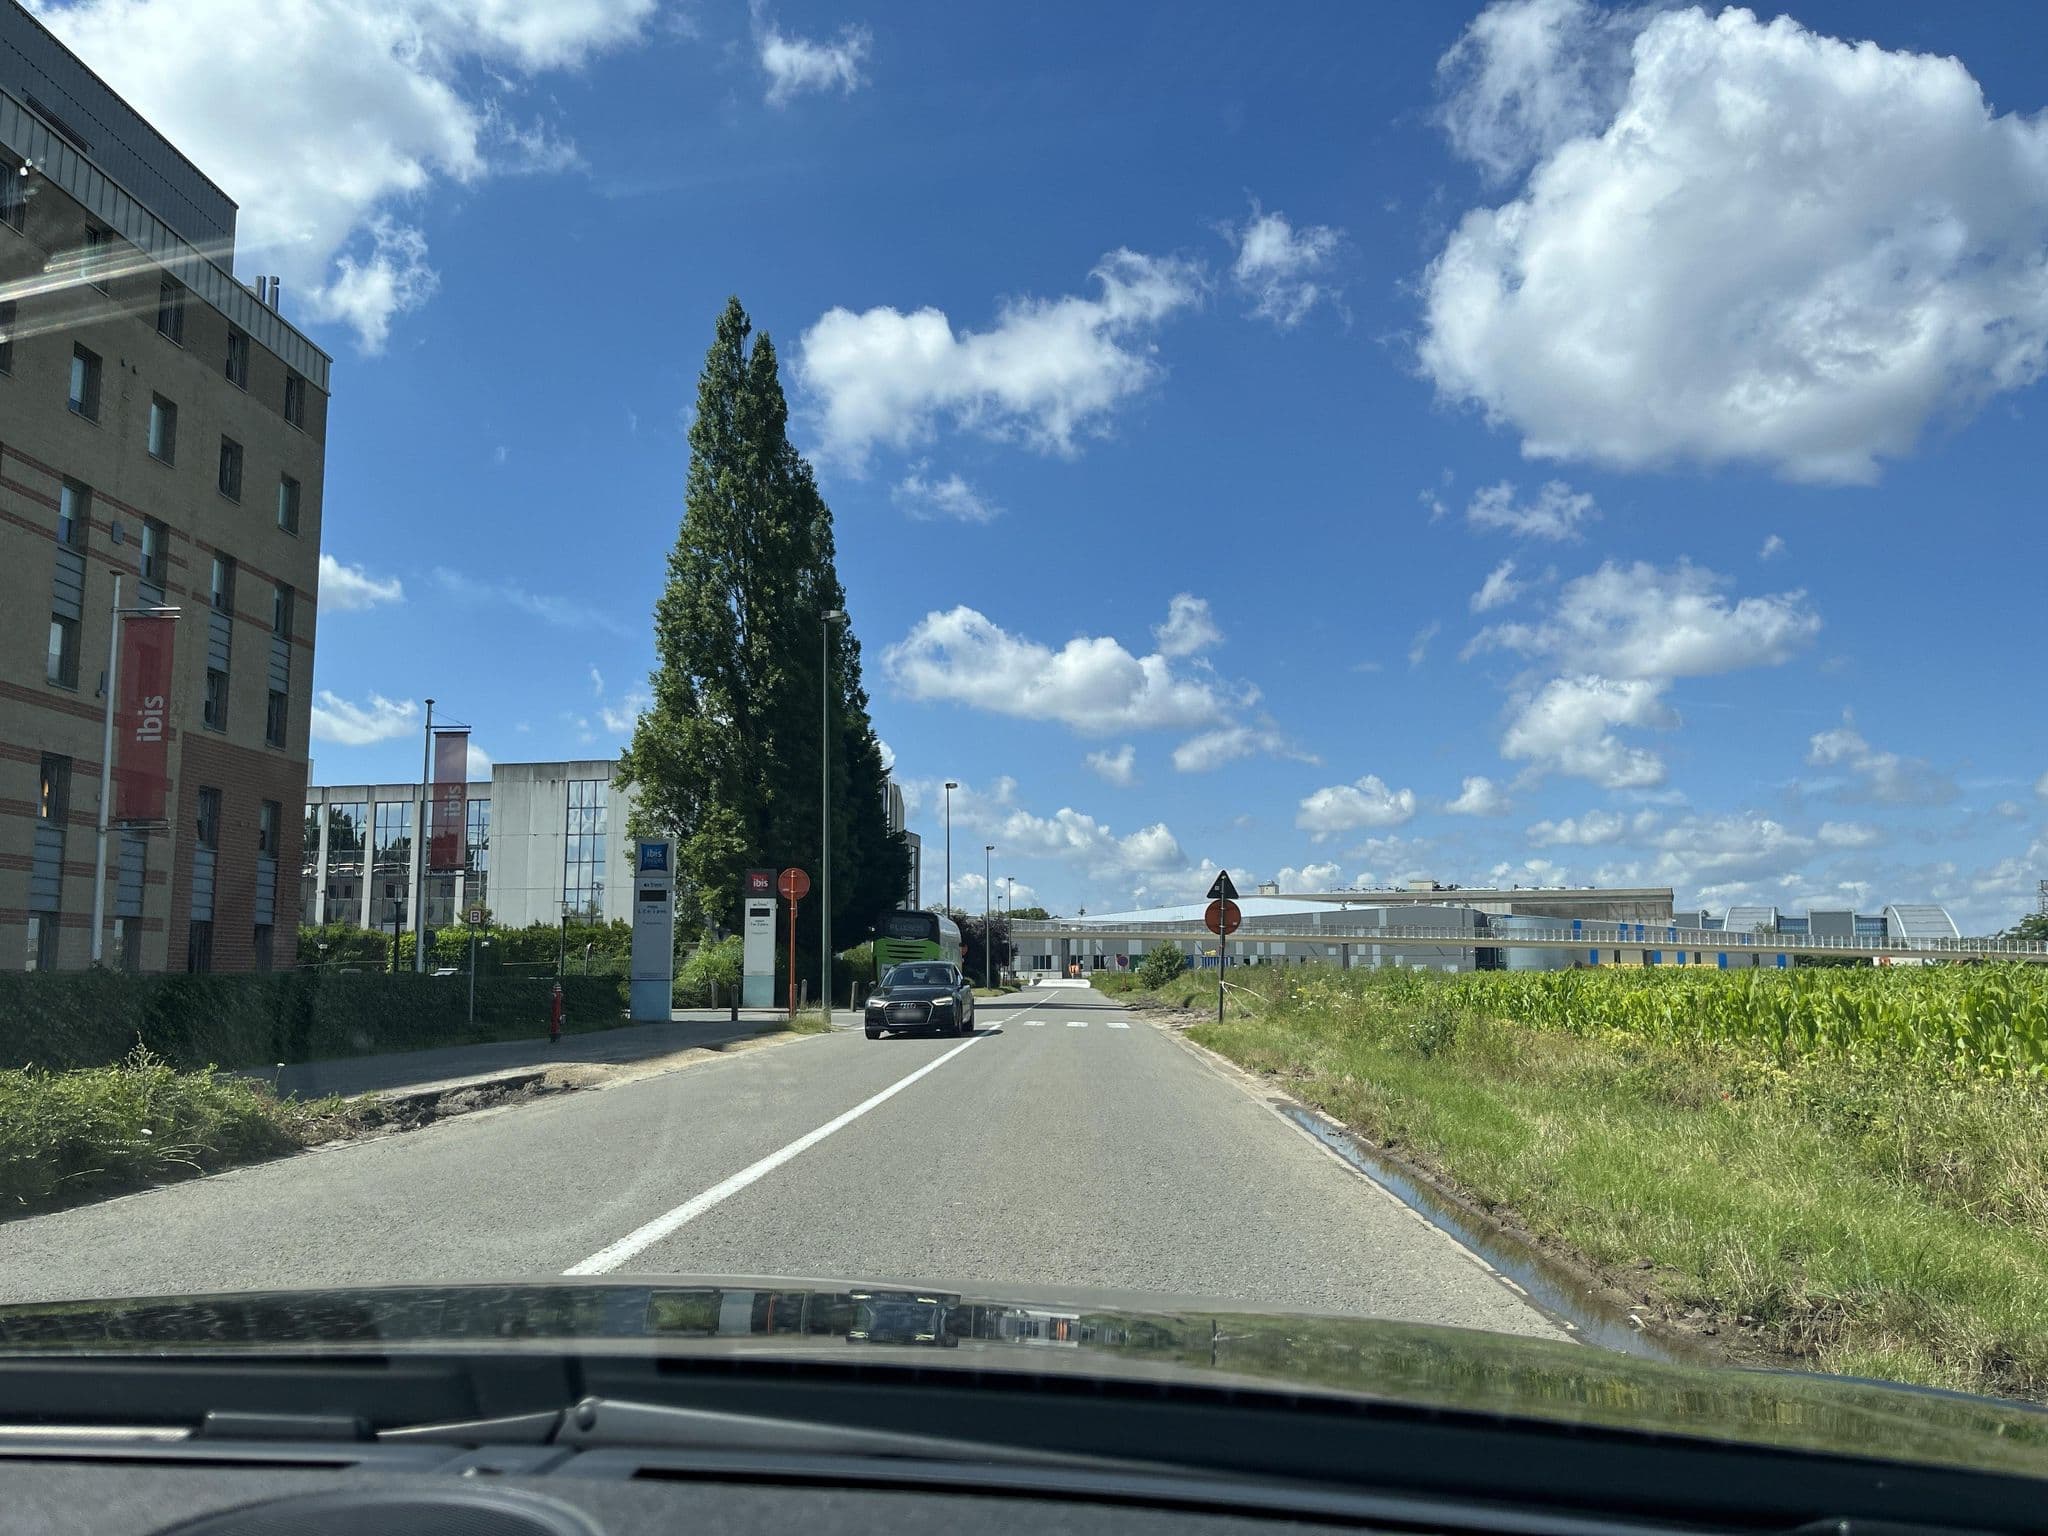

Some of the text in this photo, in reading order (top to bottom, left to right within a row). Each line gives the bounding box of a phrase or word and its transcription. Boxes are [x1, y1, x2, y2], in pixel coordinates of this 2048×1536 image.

[136, 695, 164, 742] ibis
[443, 785, 462, 817] ibis
[647, 848, 663, 858] ibis
[753, 878, 769, 888] ibis
